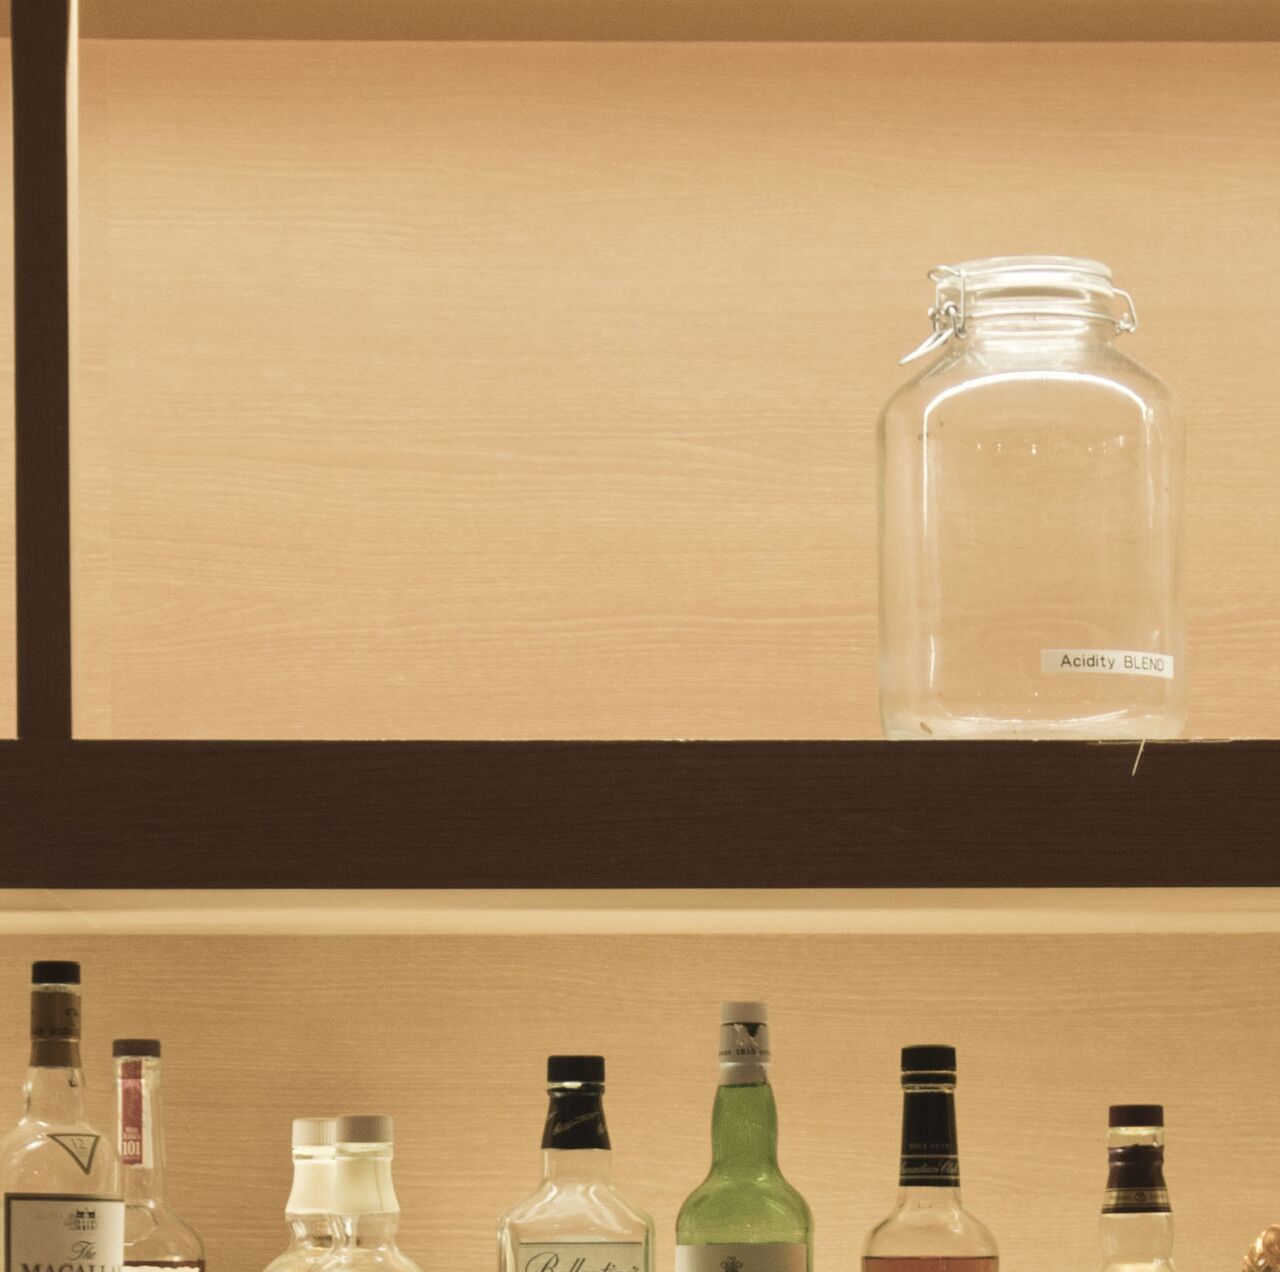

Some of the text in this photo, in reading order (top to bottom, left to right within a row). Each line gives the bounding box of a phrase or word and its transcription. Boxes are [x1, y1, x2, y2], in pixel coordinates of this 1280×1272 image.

[1060, 654, 1165, 671] Acidity BLEND
[71, 1138, 86, 1150] 12
[122, 1140, 142, 1156] 101
[70, 1240, 97, 1262] The
